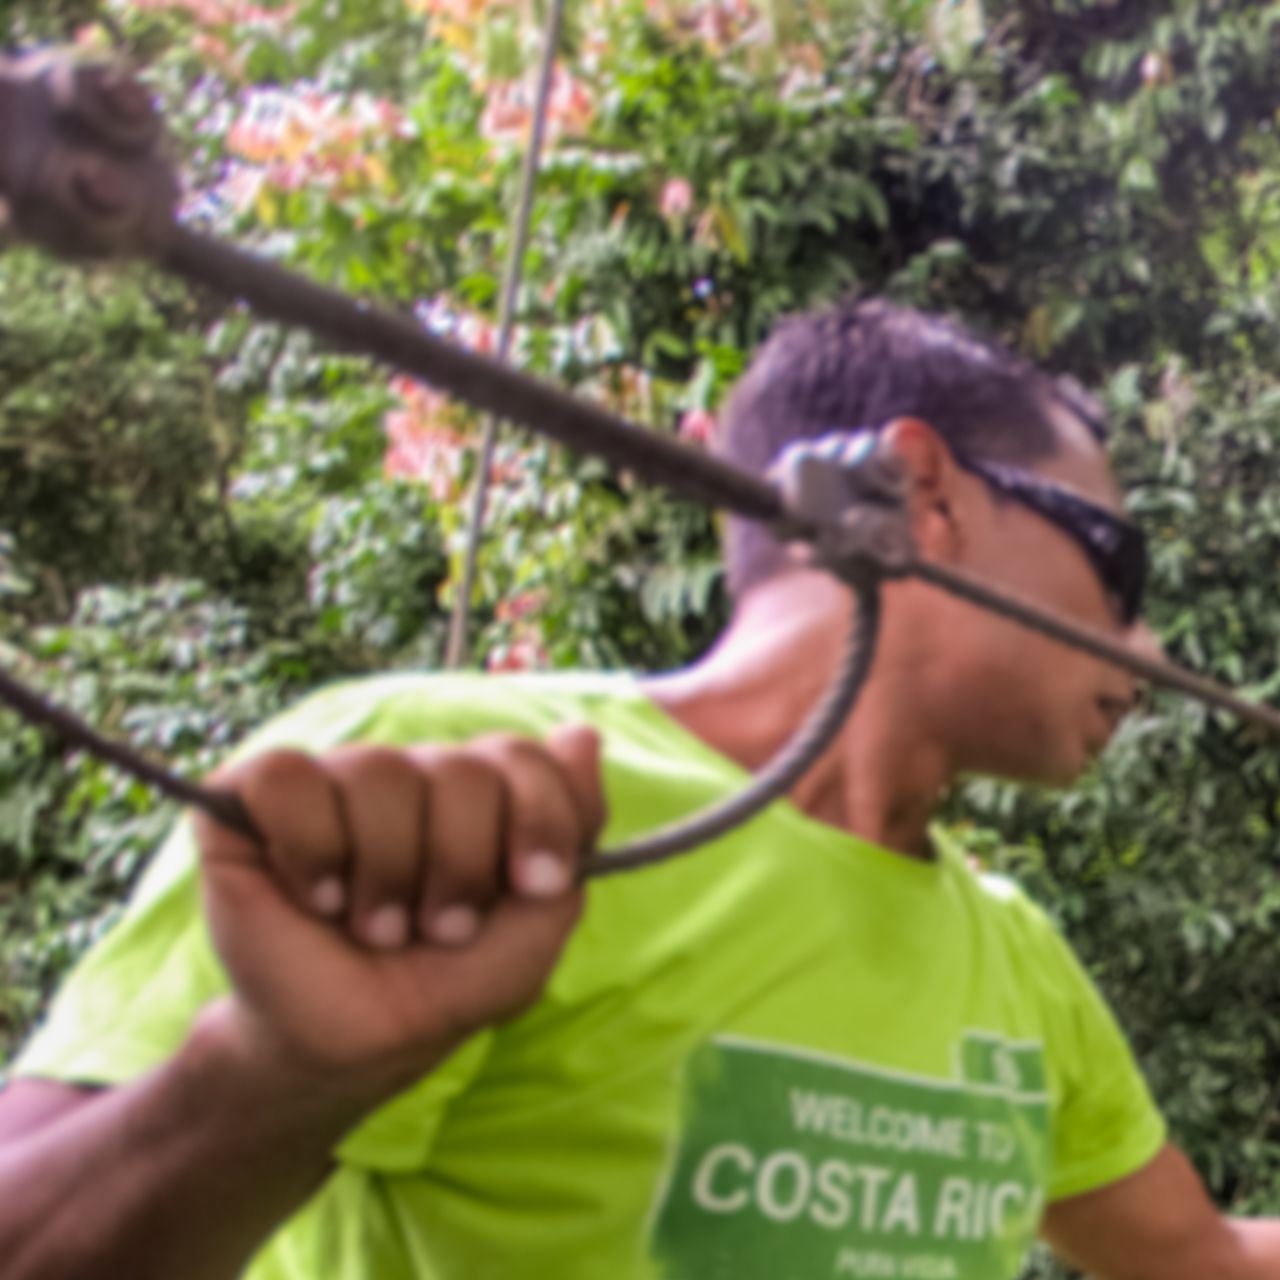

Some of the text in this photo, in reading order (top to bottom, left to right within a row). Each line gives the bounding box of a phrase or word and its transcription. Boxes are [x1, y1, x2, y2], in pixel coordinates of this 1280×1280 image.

[790, 1087, 1016, 1165] WELCOME TO
[692, 1143, 921, 1238] COSTA
